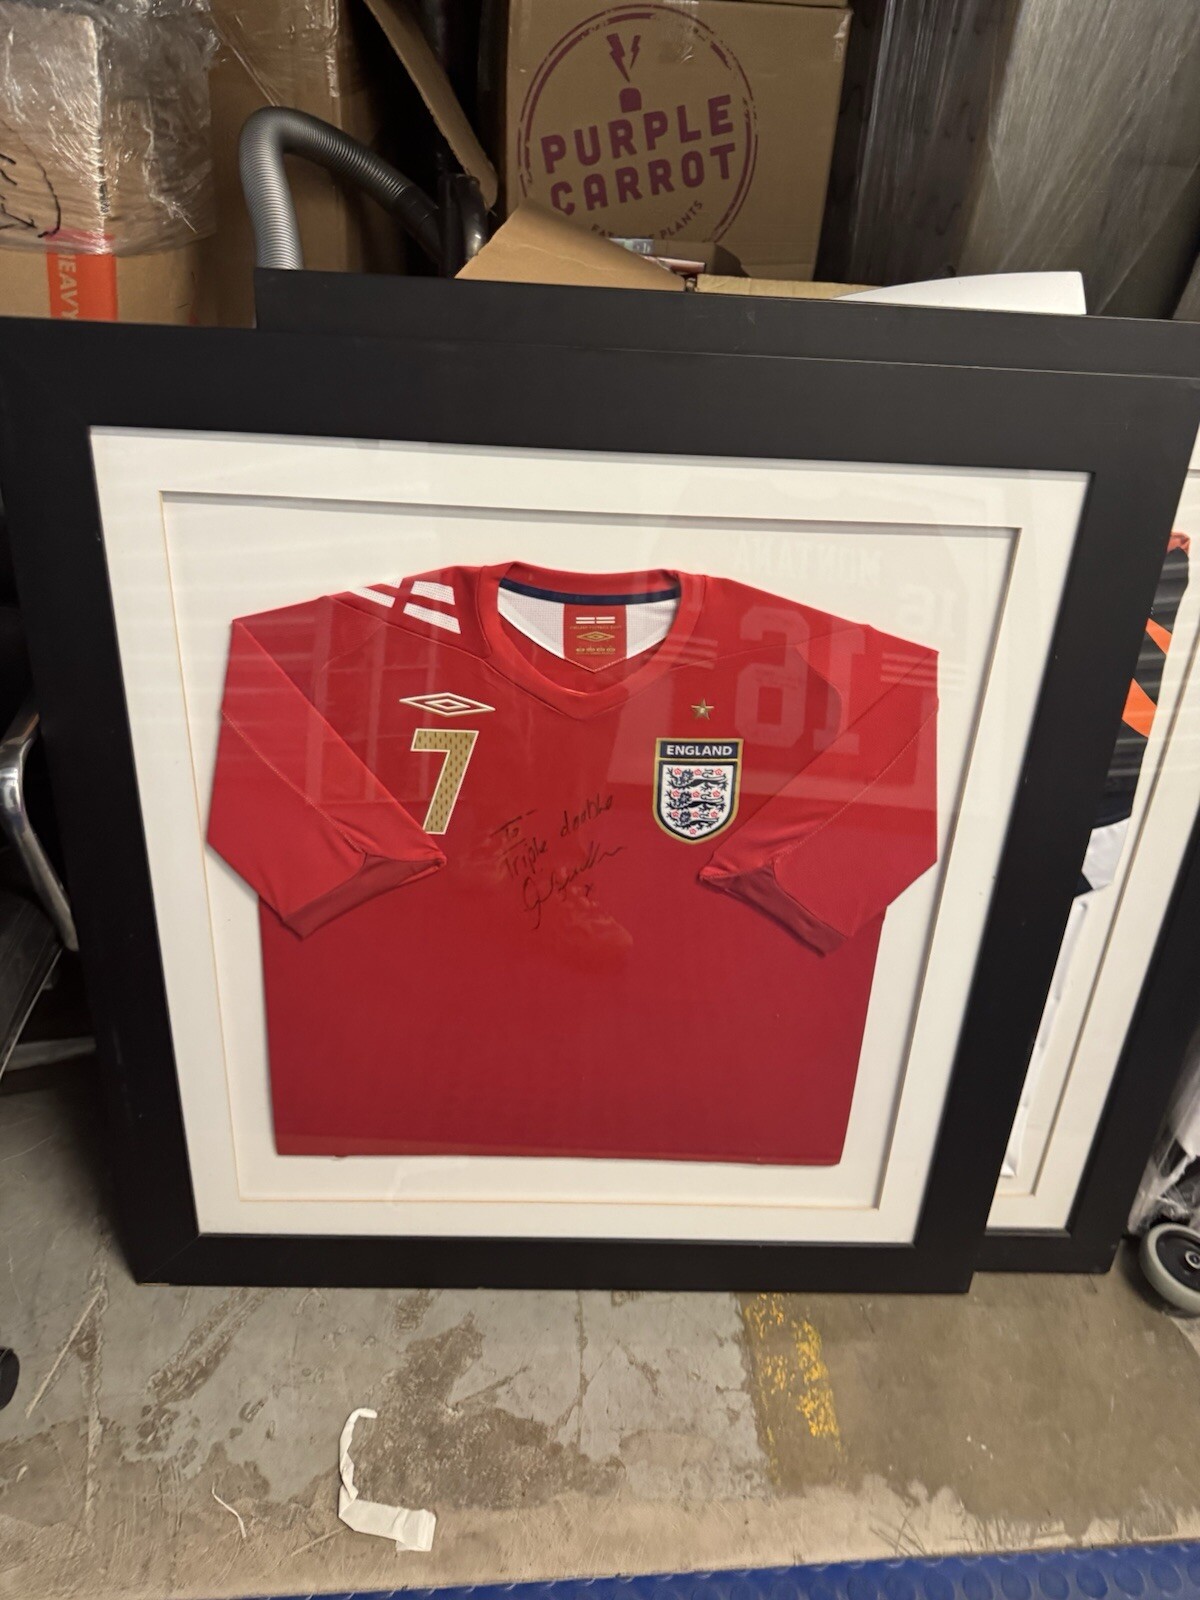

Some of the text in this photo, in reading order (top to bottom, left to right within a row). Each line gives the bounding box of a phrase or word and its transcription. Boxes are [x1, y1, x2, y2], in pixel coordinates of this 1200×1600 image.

[541, 94, 734, 174] PURPLE
[551, 143, 735, 216] CARROT
[659, 200, 703, 239] PLANTS
[57, 253, 80, 319] EAVY
[410, 728, 480, 835] 7
[666, 744, 733, 757] ENGLAND
